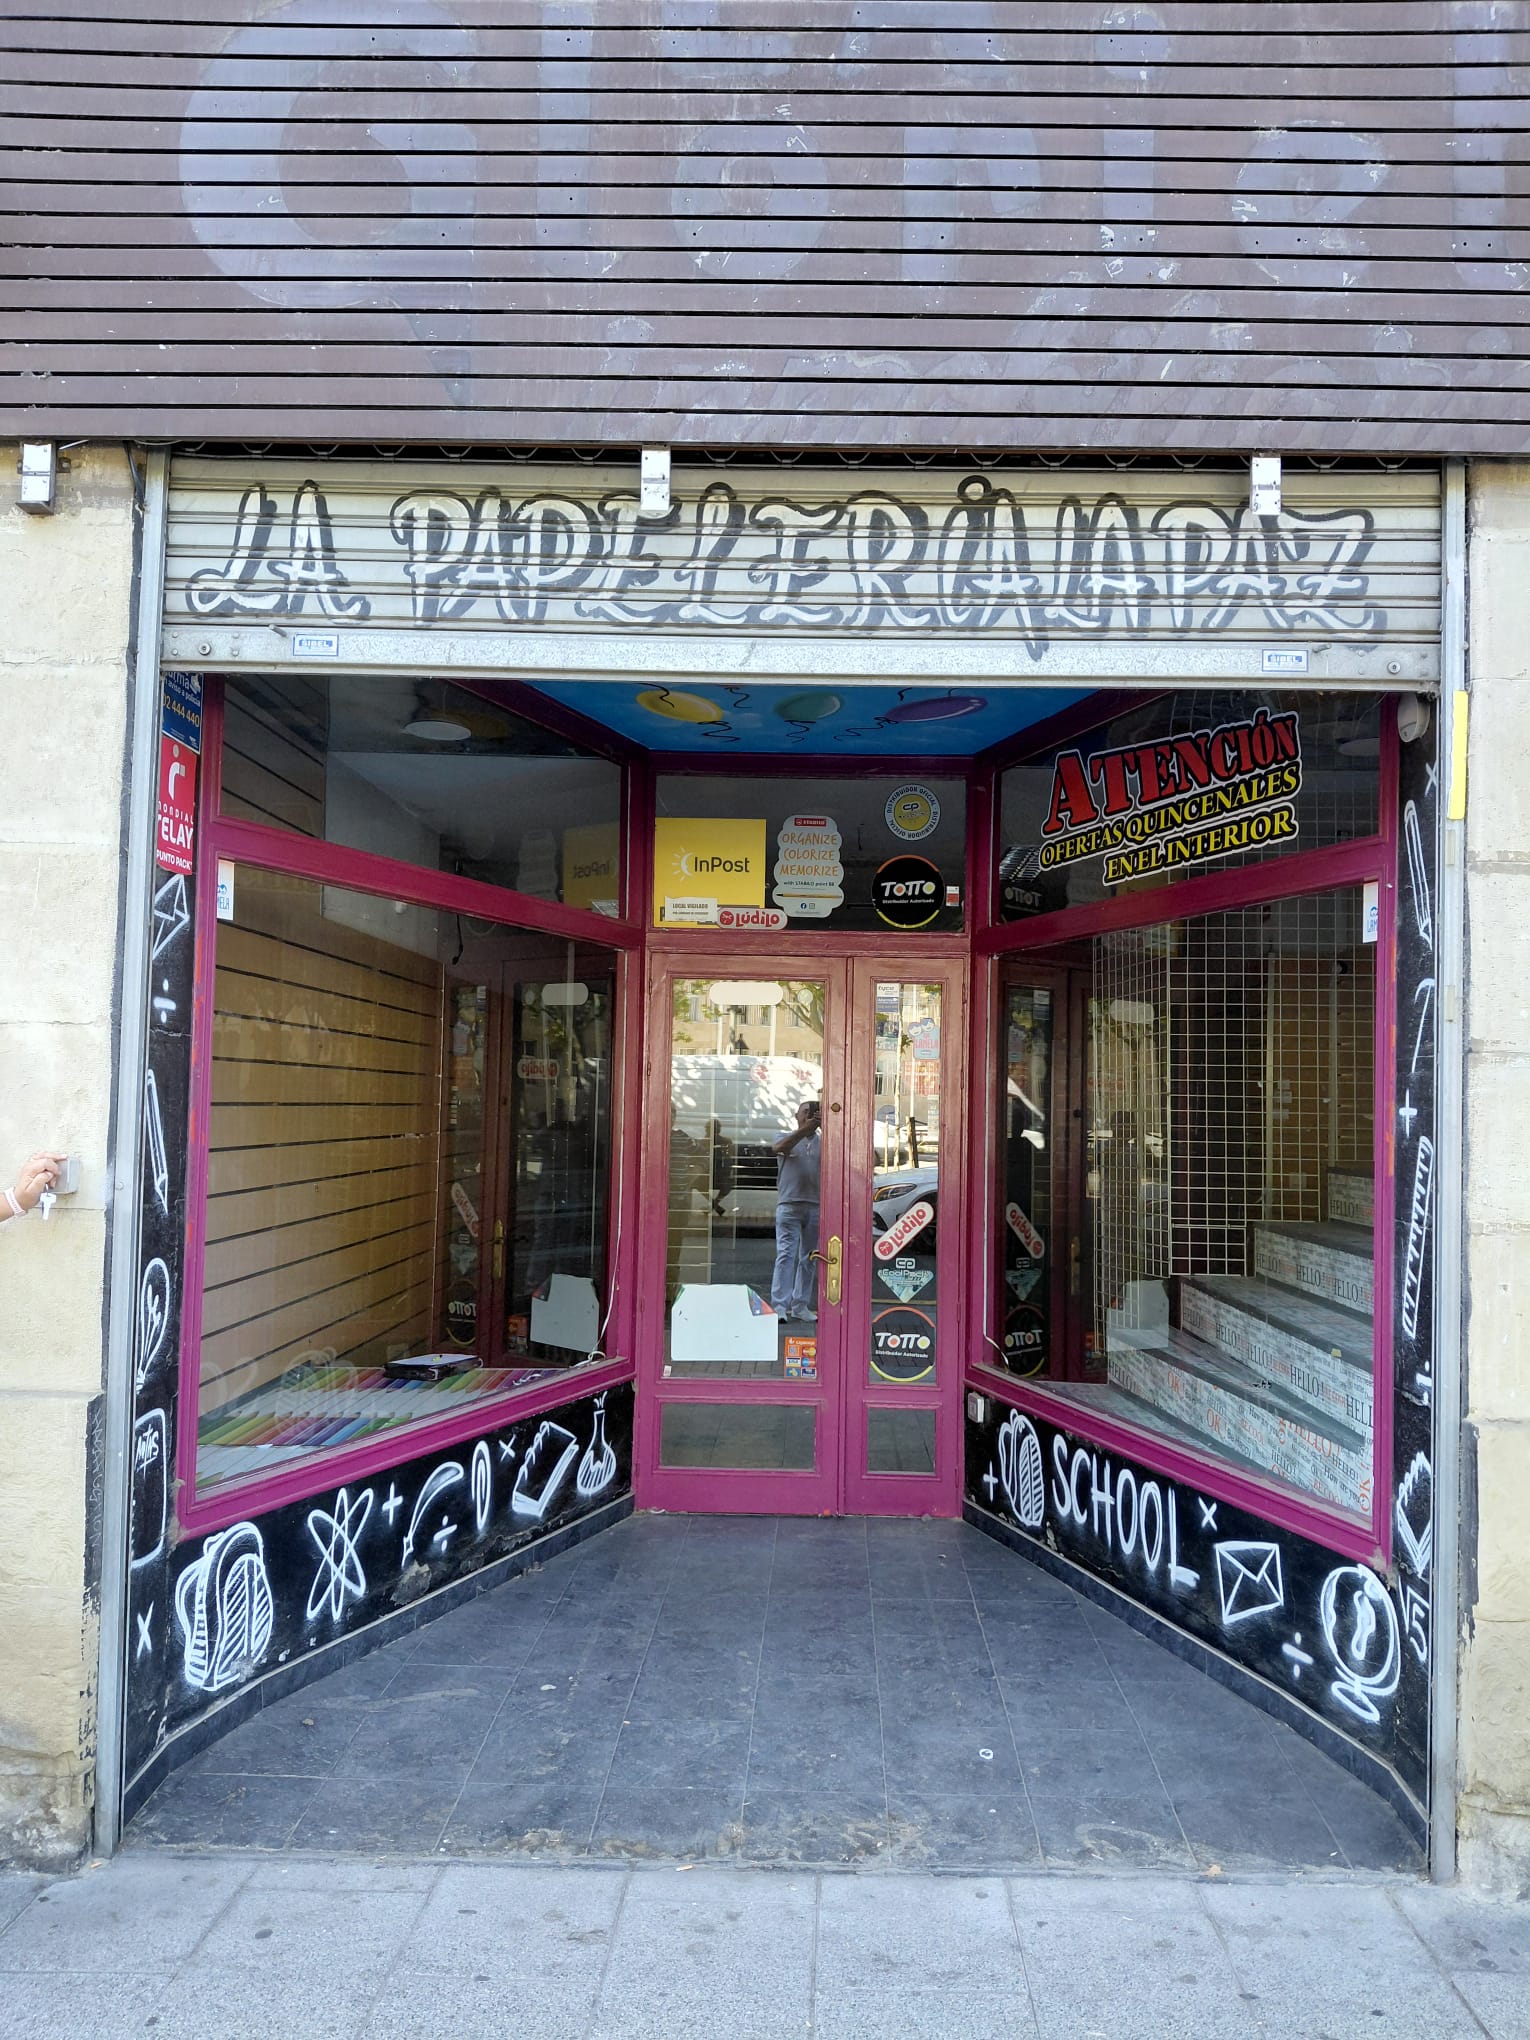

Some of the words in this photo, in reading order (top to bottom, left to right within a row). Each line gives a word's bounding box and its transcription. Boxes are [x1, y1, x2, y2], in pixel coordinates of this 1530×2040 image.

[1042, 714, 1297, 833] ATENCIÓN
[1041, 819, 1122, 868] OFERTAS
[1126, 766, 1298, 841] QUINCENALES
[782, 832, 838, 846] ORGANIZE
[783, 848, 835, 861] COLORIZE
[1106, 853, 1134, 880] EN
[1137, 844, 1163, 870] EL
[1165, 810, 1294, 866] INTERIOR
[694, 856, 750, 873] InPost
[780, 864, 839, 877] MEMORIZE
[1052, 1434, 1200, 1590] SCHOOL
